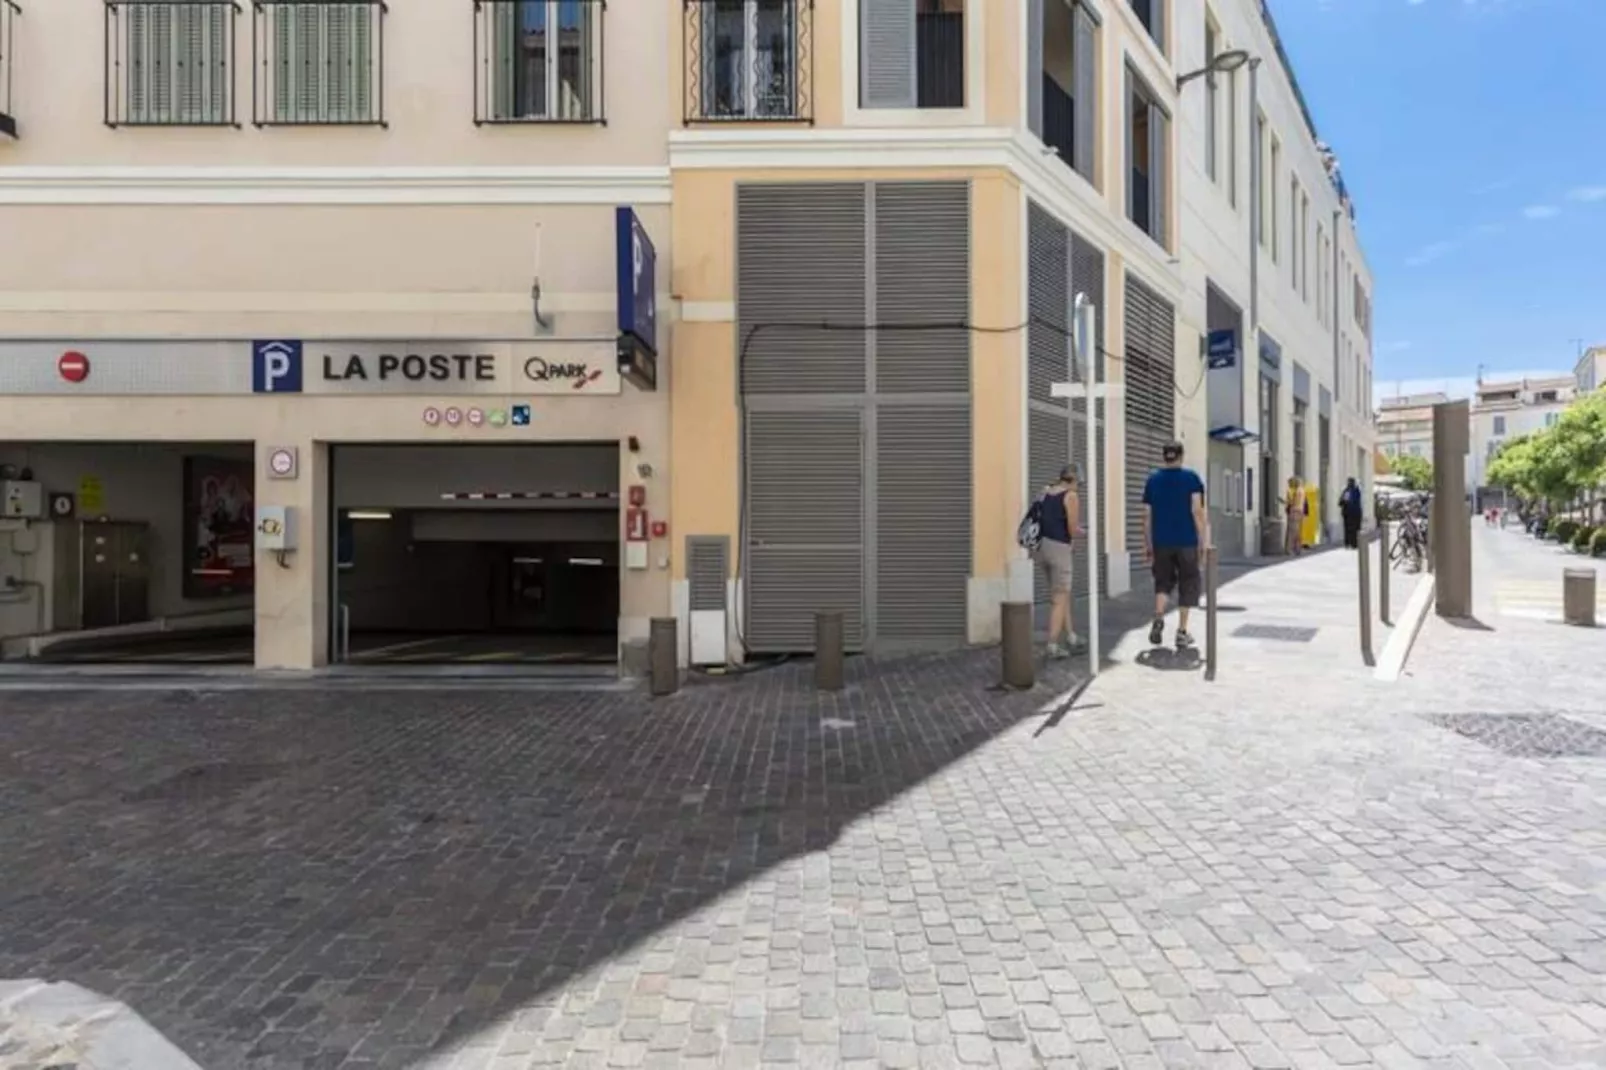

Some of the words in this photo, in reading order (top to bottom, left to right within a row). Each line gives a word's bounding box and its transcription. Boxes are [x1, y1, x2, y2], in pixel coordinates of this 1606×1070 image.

[264, 351, 290, 391] P
[323, 355, 368, 381] LA
[379, 354, 496, 381] POSTE
